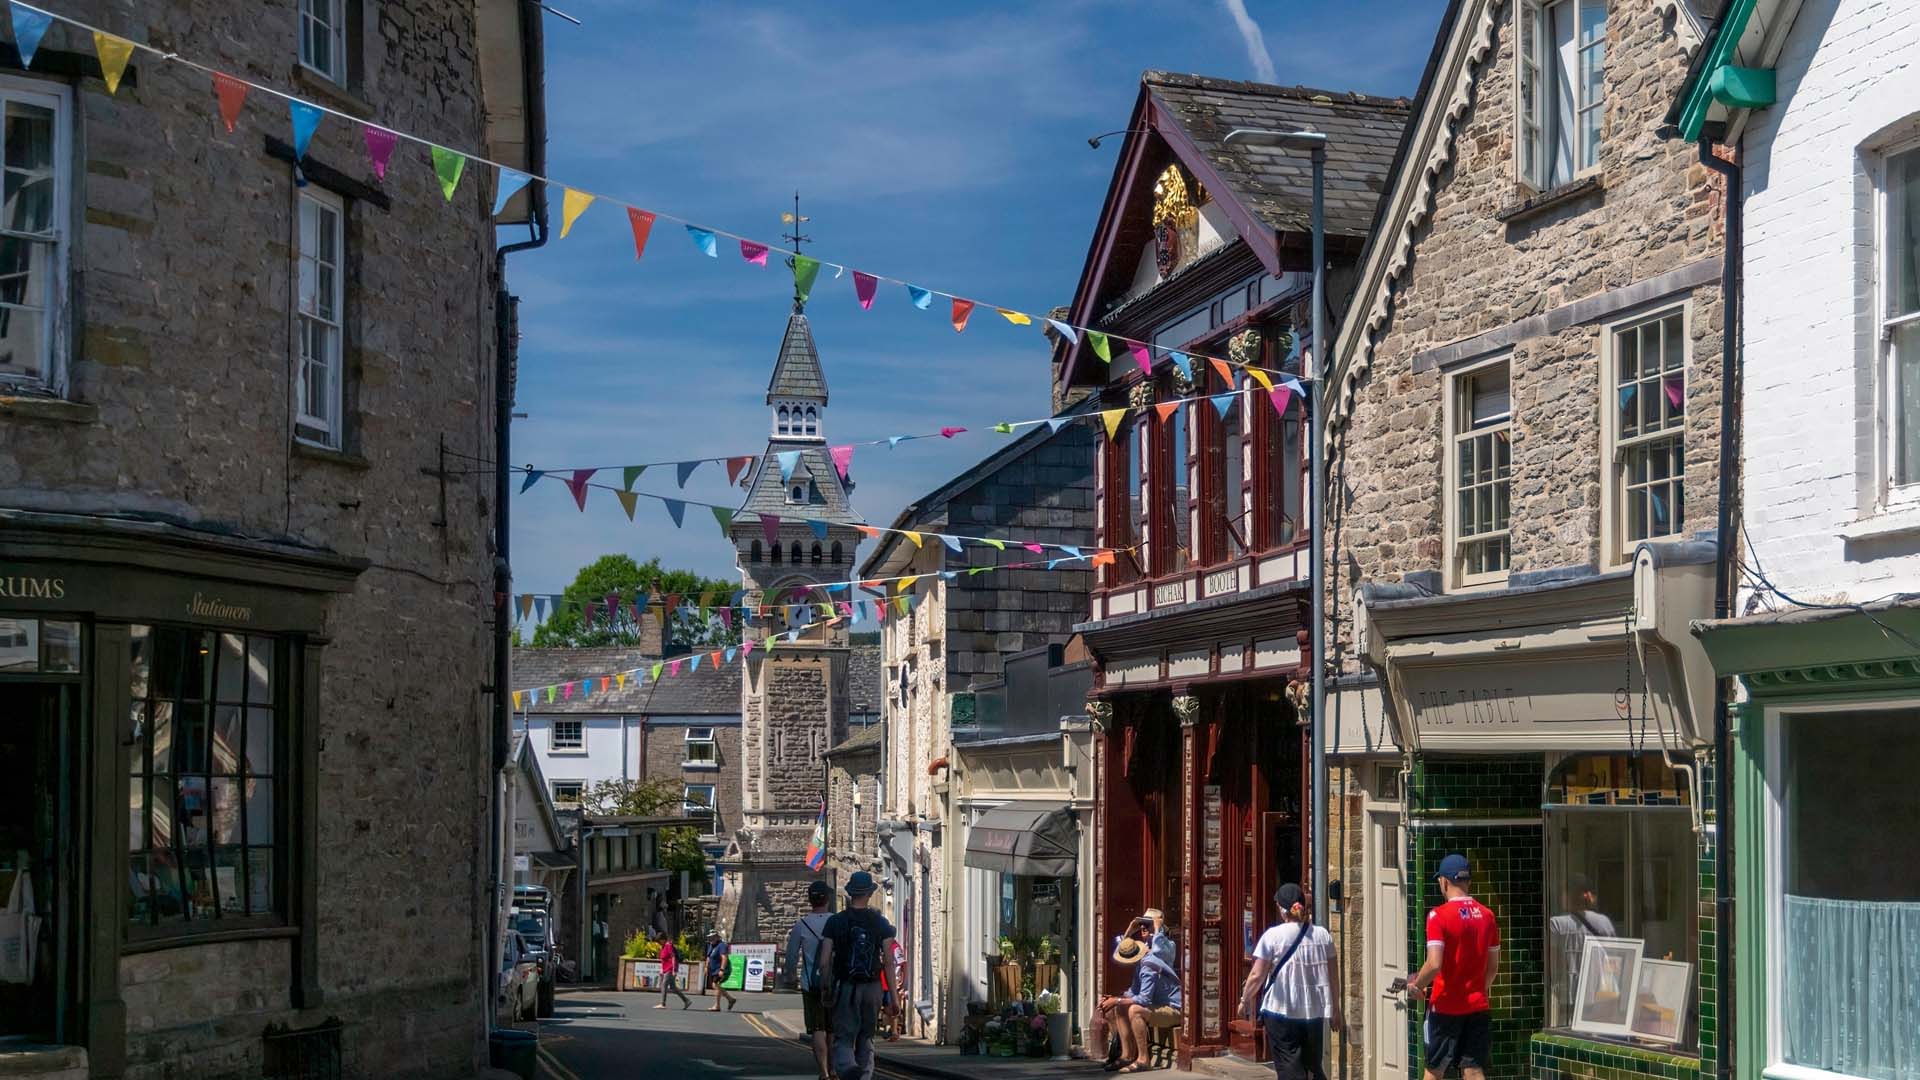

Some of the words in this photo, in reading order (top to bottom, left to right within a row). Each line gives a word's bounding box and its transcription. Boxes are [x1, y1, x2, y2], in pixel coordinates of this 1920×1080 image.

[1156, 583, 1185, 604] RICHAR
[1209, 572, 1236, 594] BOOTH
[1419, 690, 1454, 725] THE
[1458, 687, 1520, 725] TABLE
